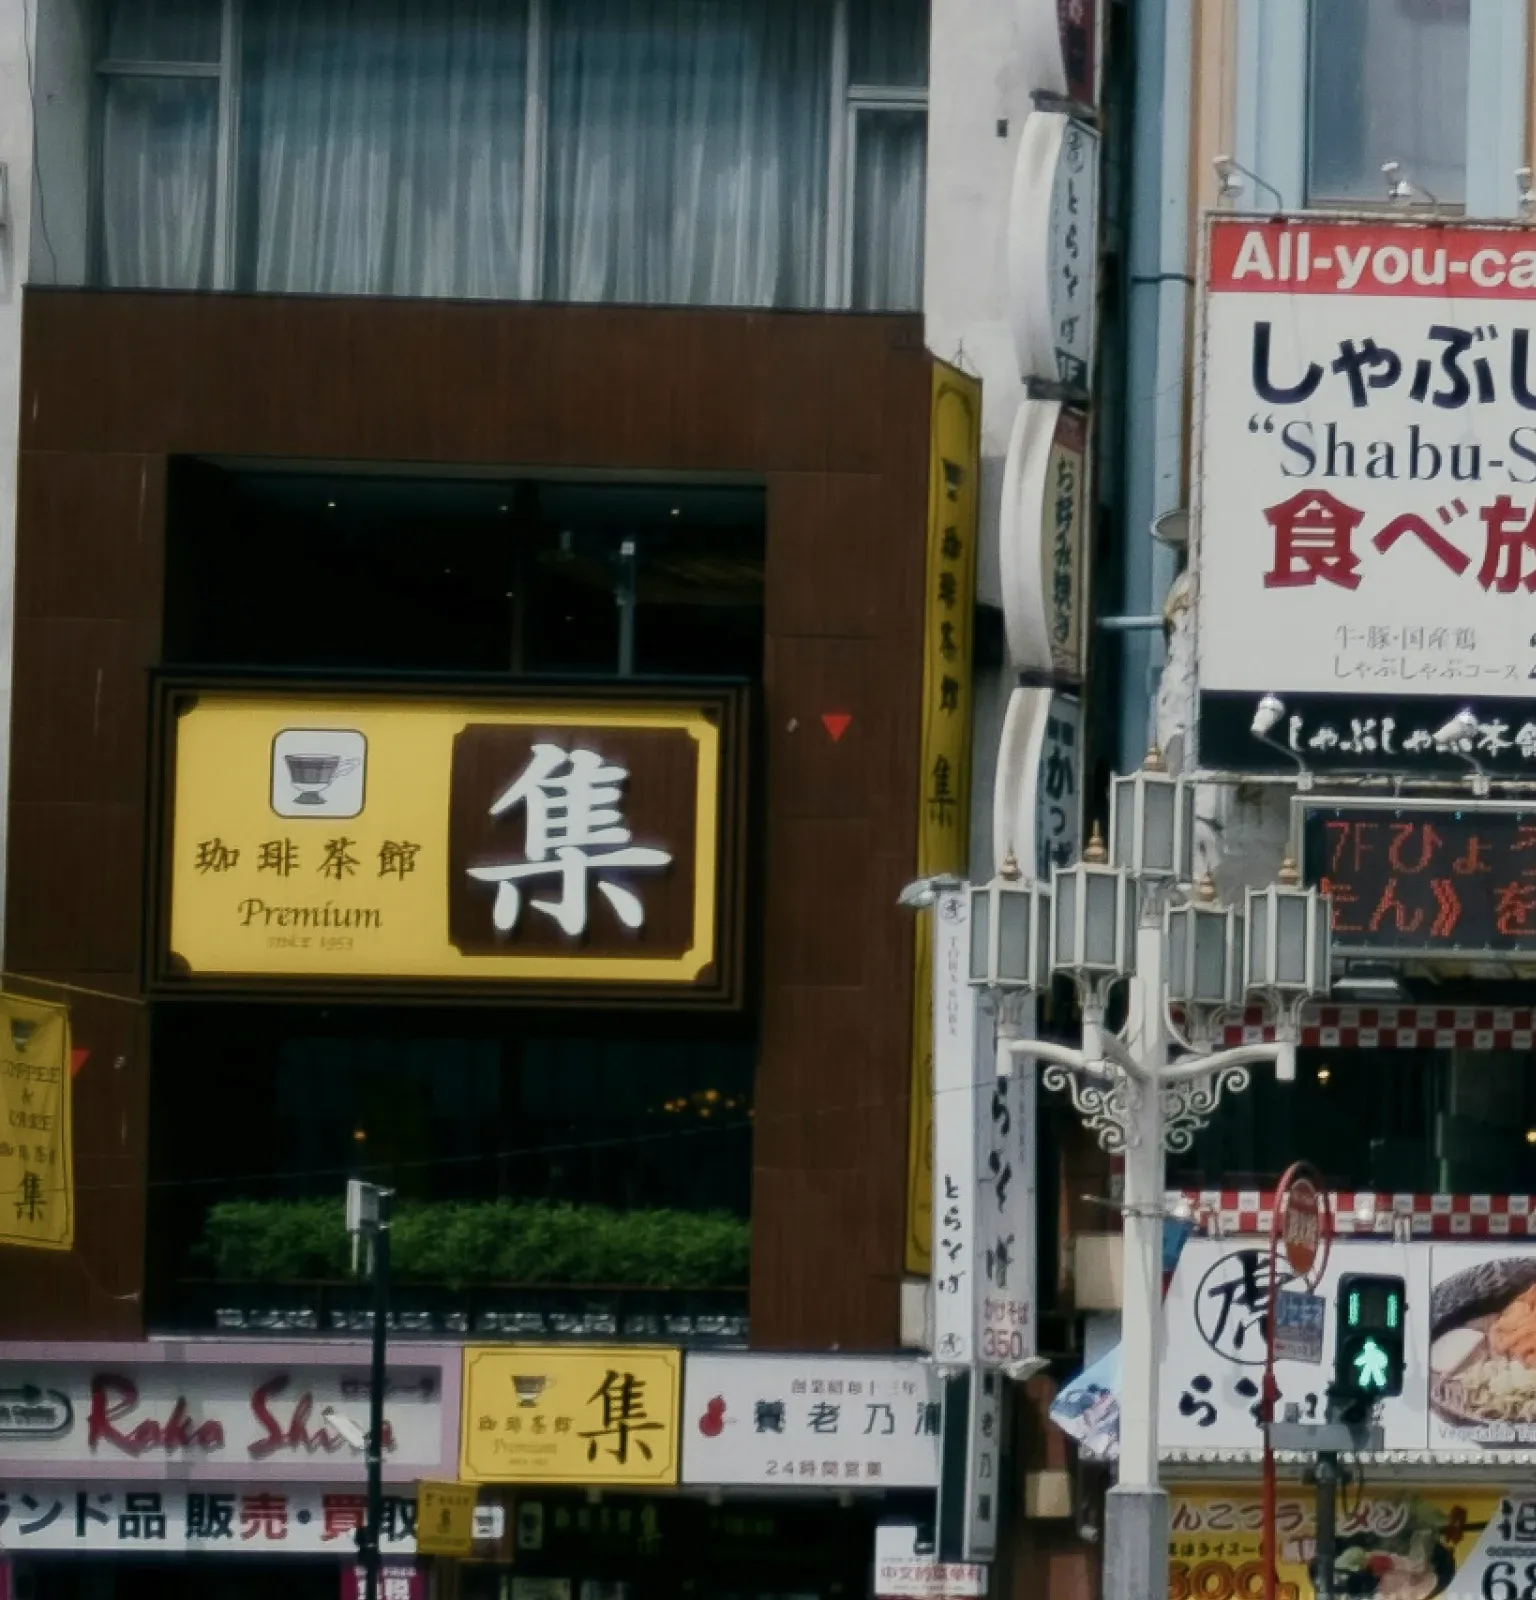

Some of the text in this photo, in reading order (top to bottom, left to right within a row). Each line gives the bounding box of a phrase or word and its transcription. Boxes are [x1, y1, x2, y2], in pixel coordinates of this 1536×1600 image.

[194, 838, 423, 882] 珈琲茶館
[465, 742, 673, 937] 集
[236, 898, 382, 930] Premium
[577, 1371, 666, 1464] 集
